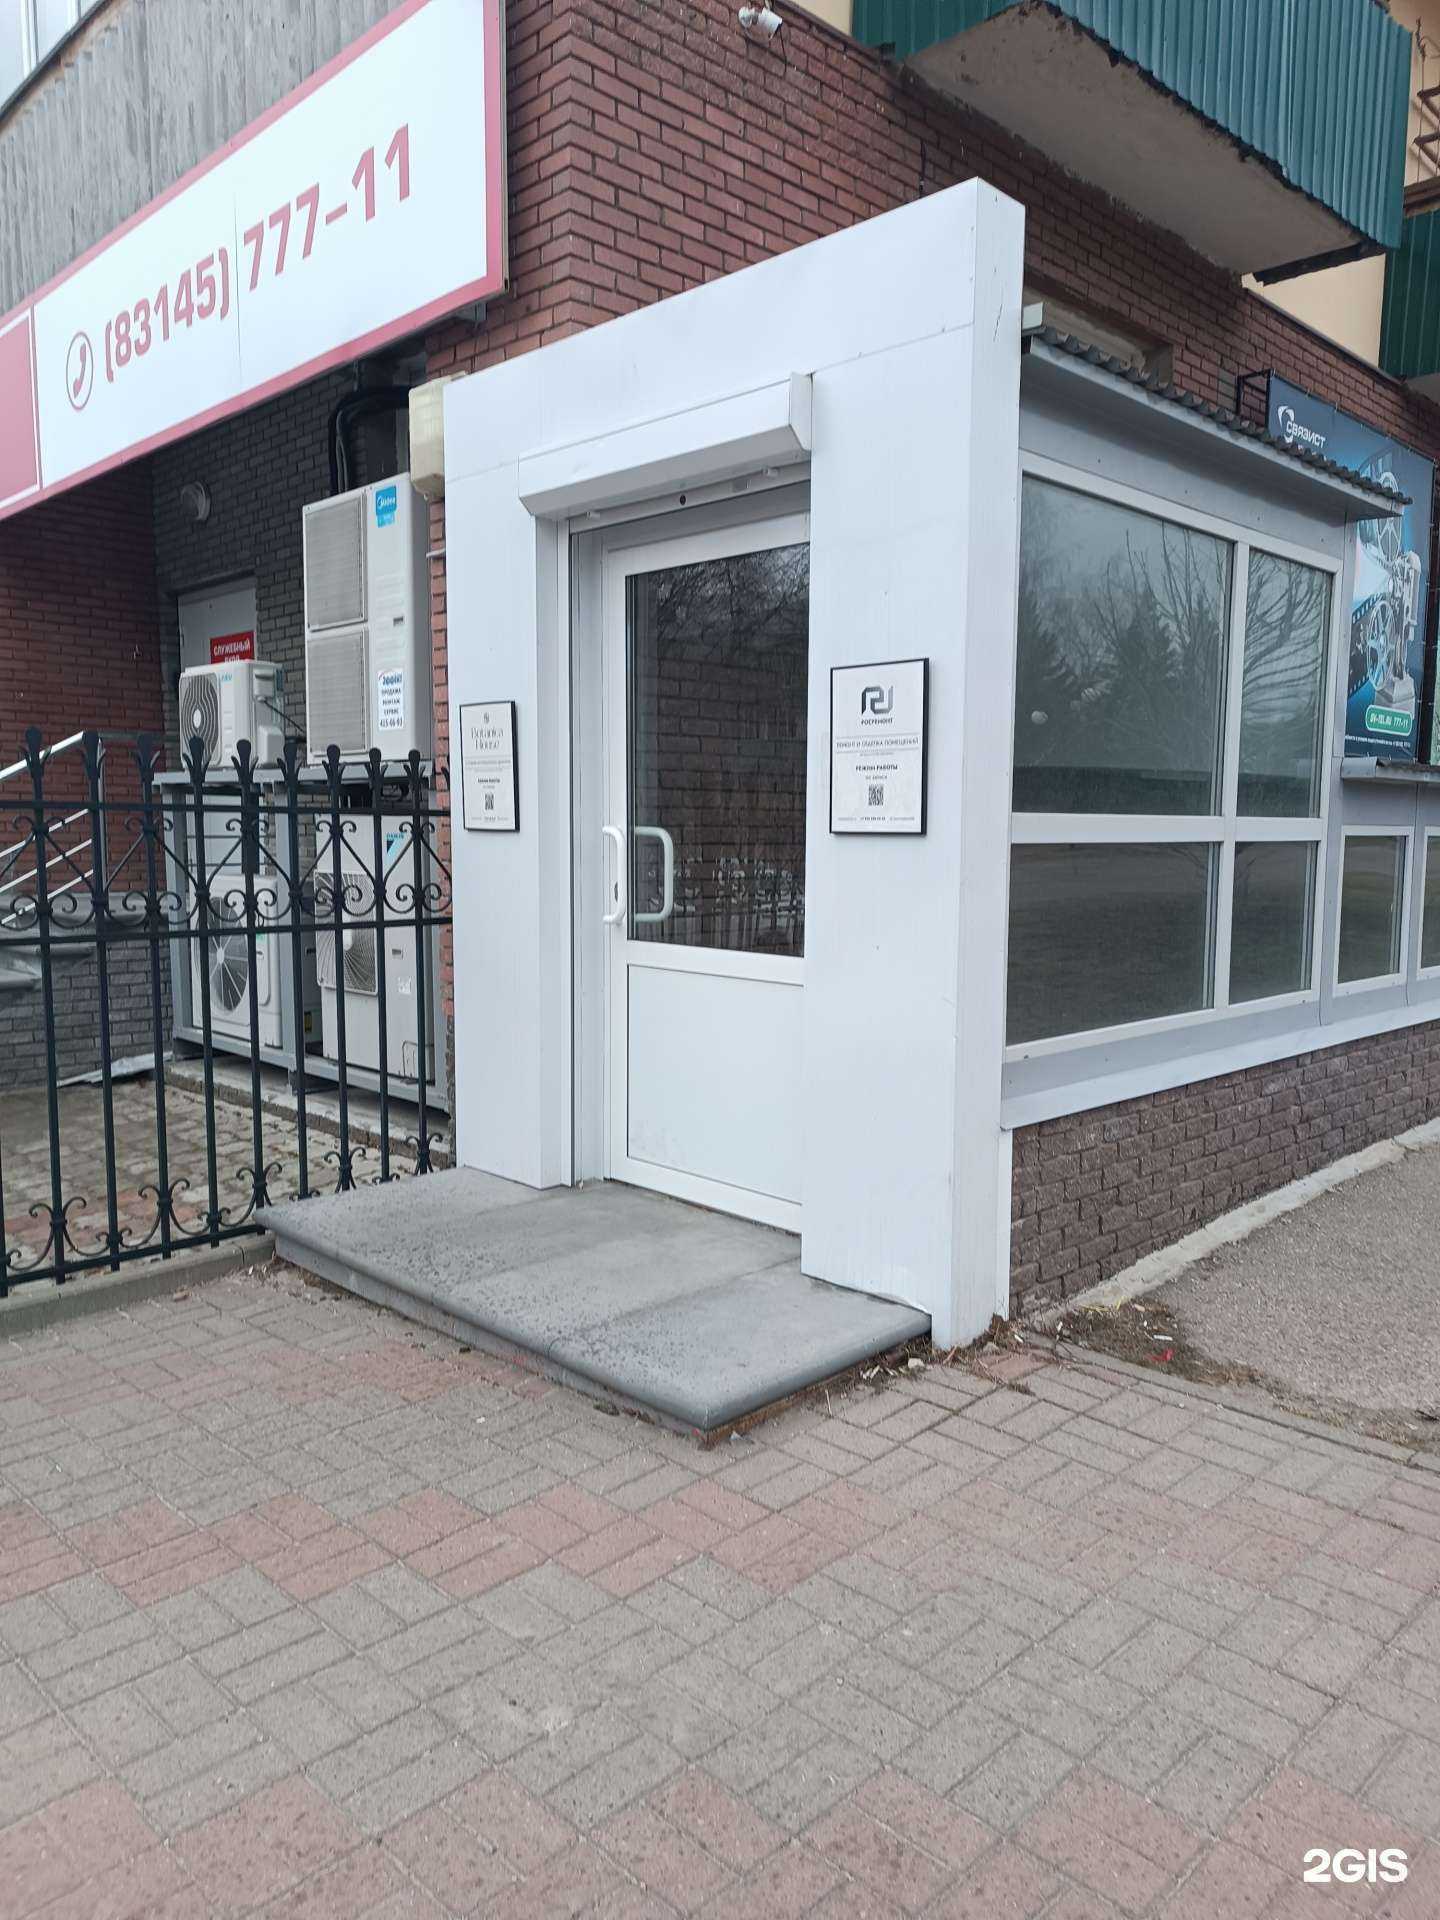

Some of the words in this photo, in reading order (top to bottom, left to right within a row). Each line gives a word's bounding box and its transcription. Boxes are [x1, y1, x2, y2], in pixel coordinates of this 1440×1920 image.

[105, 247, 229, 382] (83145)
[244, 123, 409, 292] 777-11
[1285, 420, 1326, 448] СВЯЗИСТ
[213, 638, 250, 657] СЛУЖЕБНЫЙ
